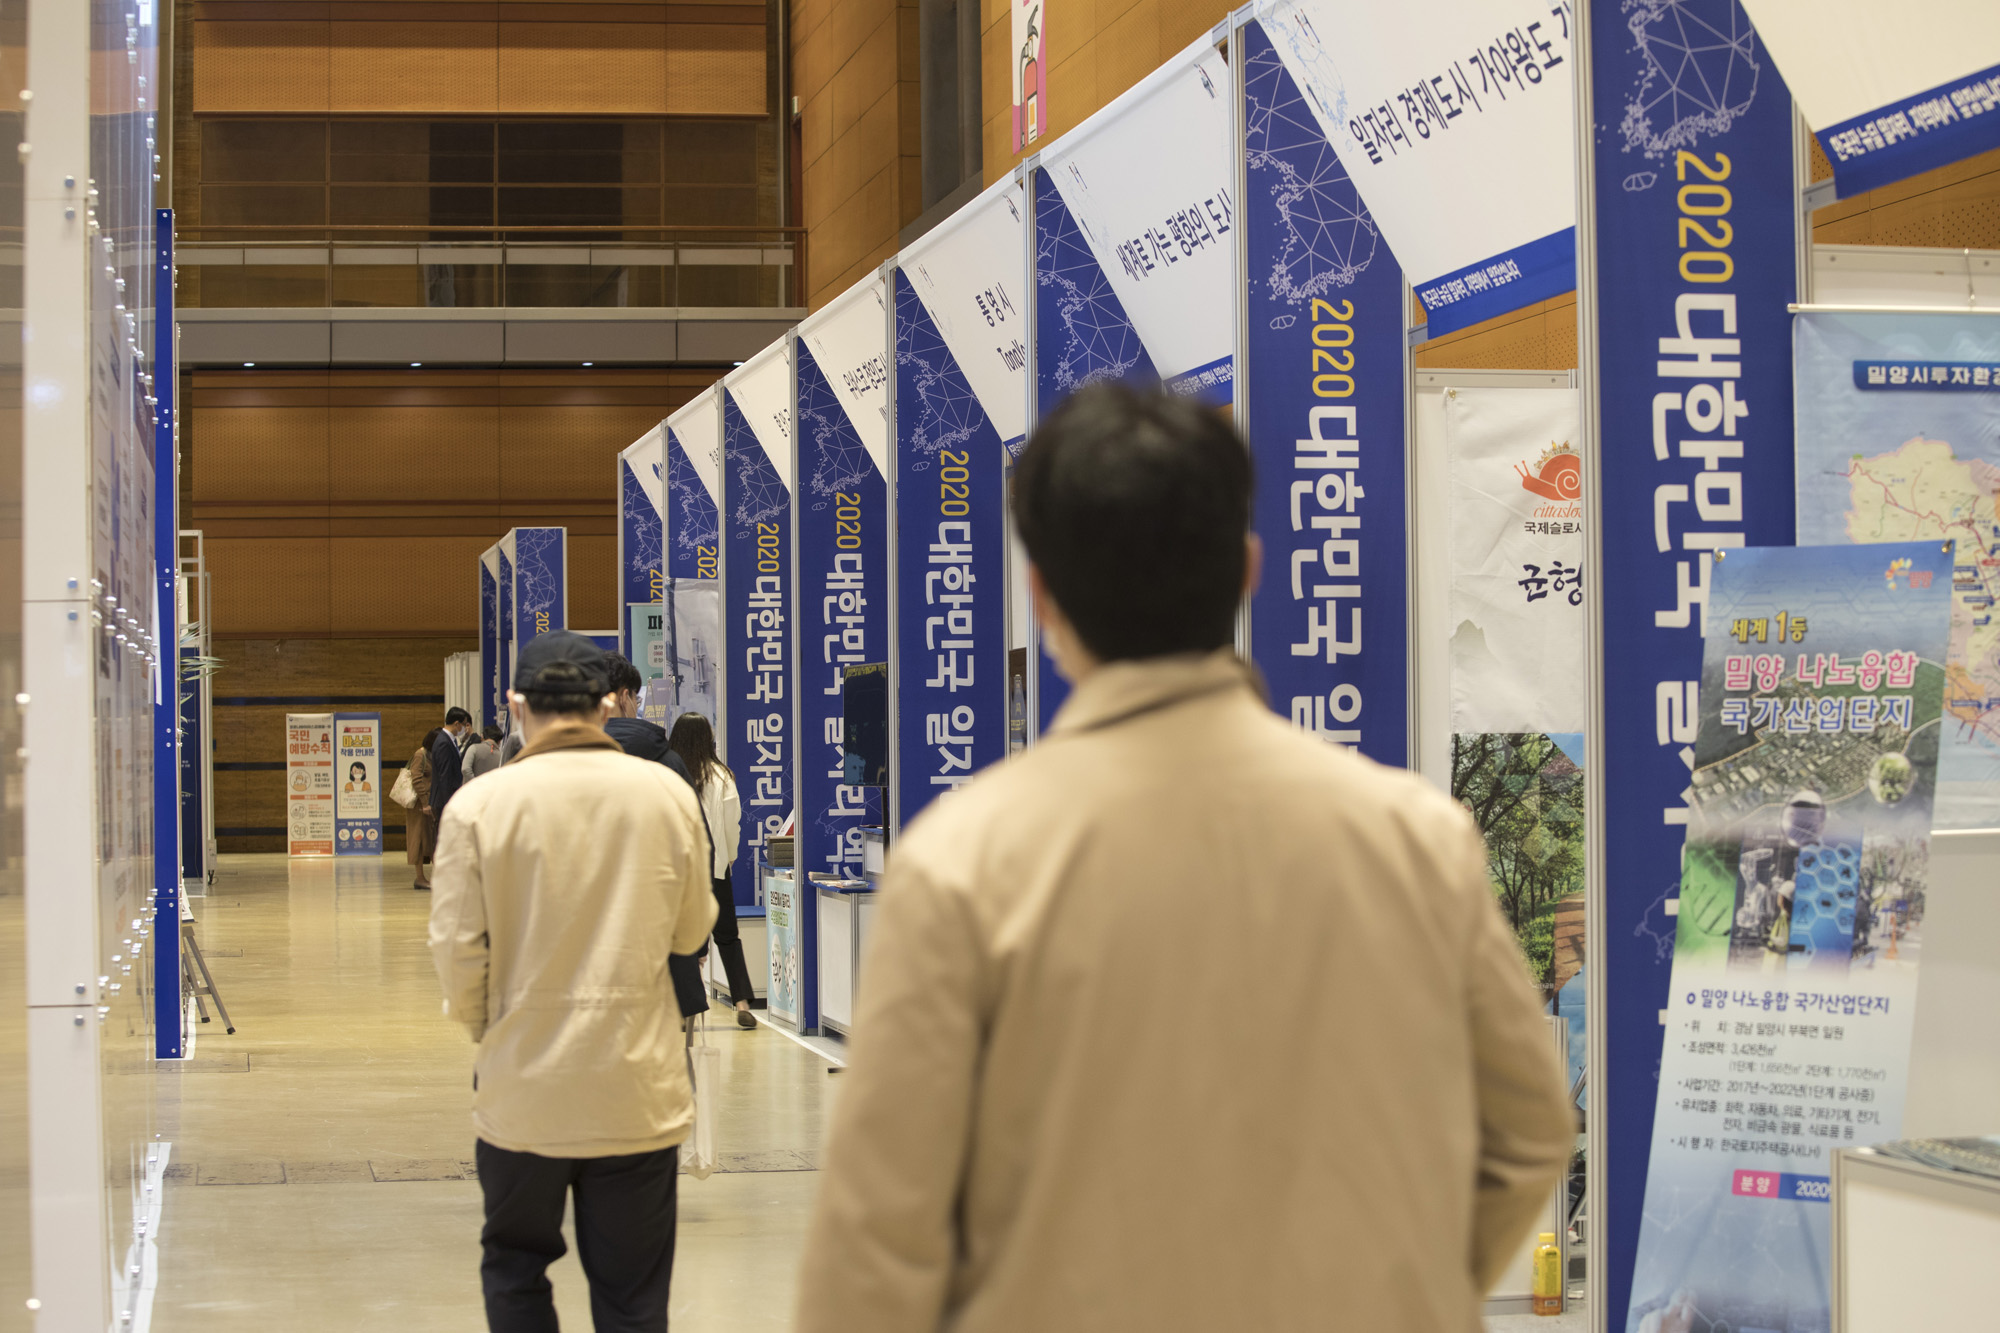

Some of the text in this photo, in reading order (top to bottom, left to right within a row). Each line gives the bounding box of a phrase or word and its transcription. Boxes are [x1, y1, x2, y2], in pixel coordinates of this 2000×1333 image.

[1349, 21, 1564, 165] 일자리 경제도시 가야왕도
[1676, 150, 1734, 283] 2020
[1115, 239, 1155, 282] 세계로
[1144, 227, 1179, 268] 가는
[1165, 203, 1216, 258] 평화의
[975, 282, 1016, 328] 통영시
[1311, 299, 1355, 398] 2020
[836, 492, 862, 550] 2020
[1290, 405, 1366, 664] 대한민국
[757, 522, 780, 573] 2020
[746, 575, 785, 704] 대한민국
[925, 450, 977, 802] 2020 대한민국 일자
[1730, 617, 1768, 644] 세계
[1725, 650, 1919, 692] 밀양 나노융합
[289, 729, 310, 742] 국민
[1720, 695, 1913, 735] 국가산업단지
[289, 742, 331, 755] 예방수칙
[342, 735, 373, 748] 마스크
[746, 712, 784, 806] 일자리
[1701, 989, 1890, 1015] 밀양 나노융합 국가산업단지
[1795, 1180, 1831, 1199] 2020
